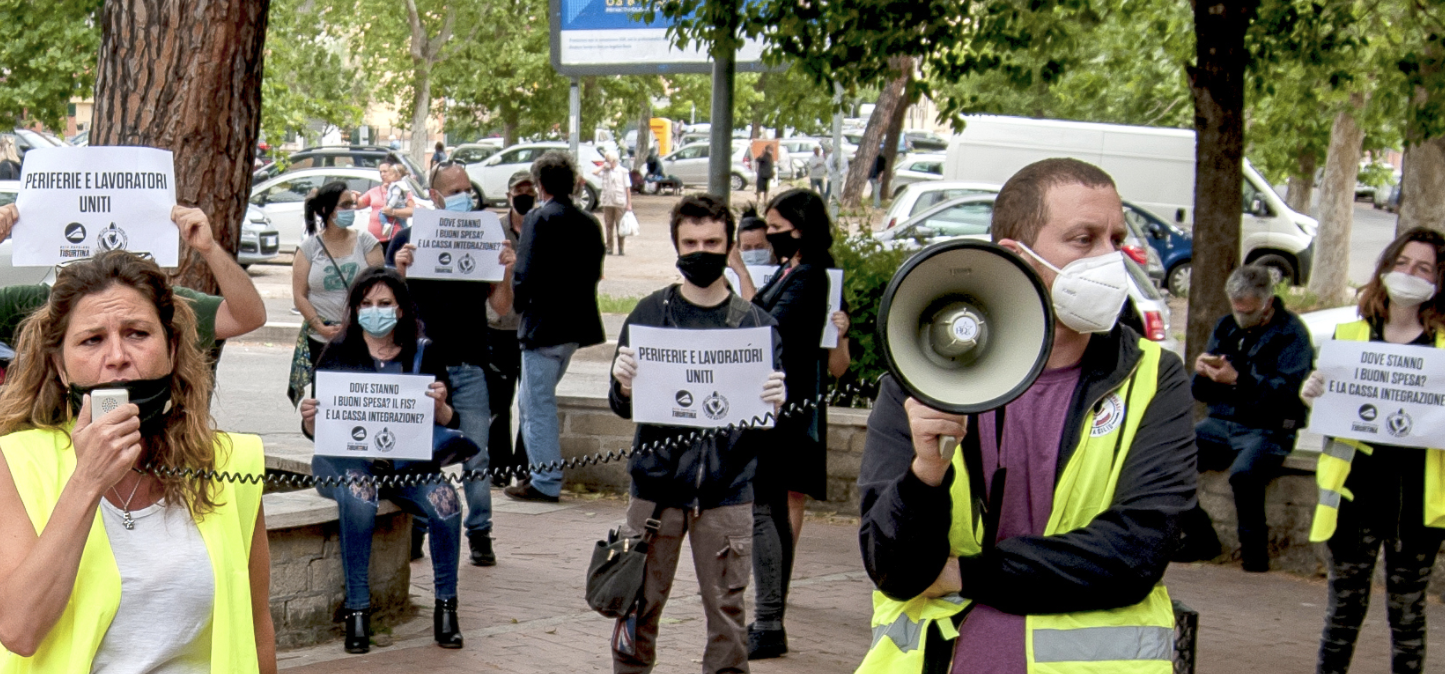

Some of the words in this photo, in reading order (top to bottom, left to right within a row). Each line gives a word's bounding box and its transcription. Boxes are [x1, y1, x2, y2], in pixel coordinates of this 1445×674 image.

[25, 172, 81, 189] PERIFERIE
[85, 172, 92, 189] E
[94, 172, 167, 189] LAVORATORI
[79, 195, 111, 213] UNITI
[439, 218, 456, 227] DOVE
[457, 219, 481, 228] STANNO
[436, 229, 438, 238] I
[439, 229, 460, 239] BUONI
[460, 230, 484, 239] SPESA?
[418, 239, 421, 248] E
[422, 239, 430, 248] LA
[431, 240, 452, 249] CASSA
[453, 241, 501, 251] INTEGRAZIONE?
[639, 347, 687, 364] PERIFERIE
[690, 350, 695, 364] E
[1361, 351, 1386, 365] DOVE
[1387, 354, 1424, 370] STANNO
[686, 369, 713, 383] UNITI
[1355, 367, 1359, 379] I
[1360, 368, 1389, 383] BUONI
[1391, 372, 1427, 387] SPESA?
[350, 382, 369, 394] DOVE
[370, 383, 399, 395] STANNO
[1329, 380, 1334, 392] E
[1336, 381, 1346, 394] LA
[1349, 383, 1378, 398] CASSA
[334, 396, 336, 406] I
[338, 396, 361, 407] BUONI
[363, 397, 390, 408] SPESA?
[393, 398, 398, 409] IL
[401, 399, 416, 409] FIS?
[326, 409, 330, 419] E
[332, 410, 340, 420] LA
[342, 410, 366, 421] CASSA
[368, 411, 424, 423] INTEGRAZIONE?
[1089, 422, 1113, 435] ASILIO
